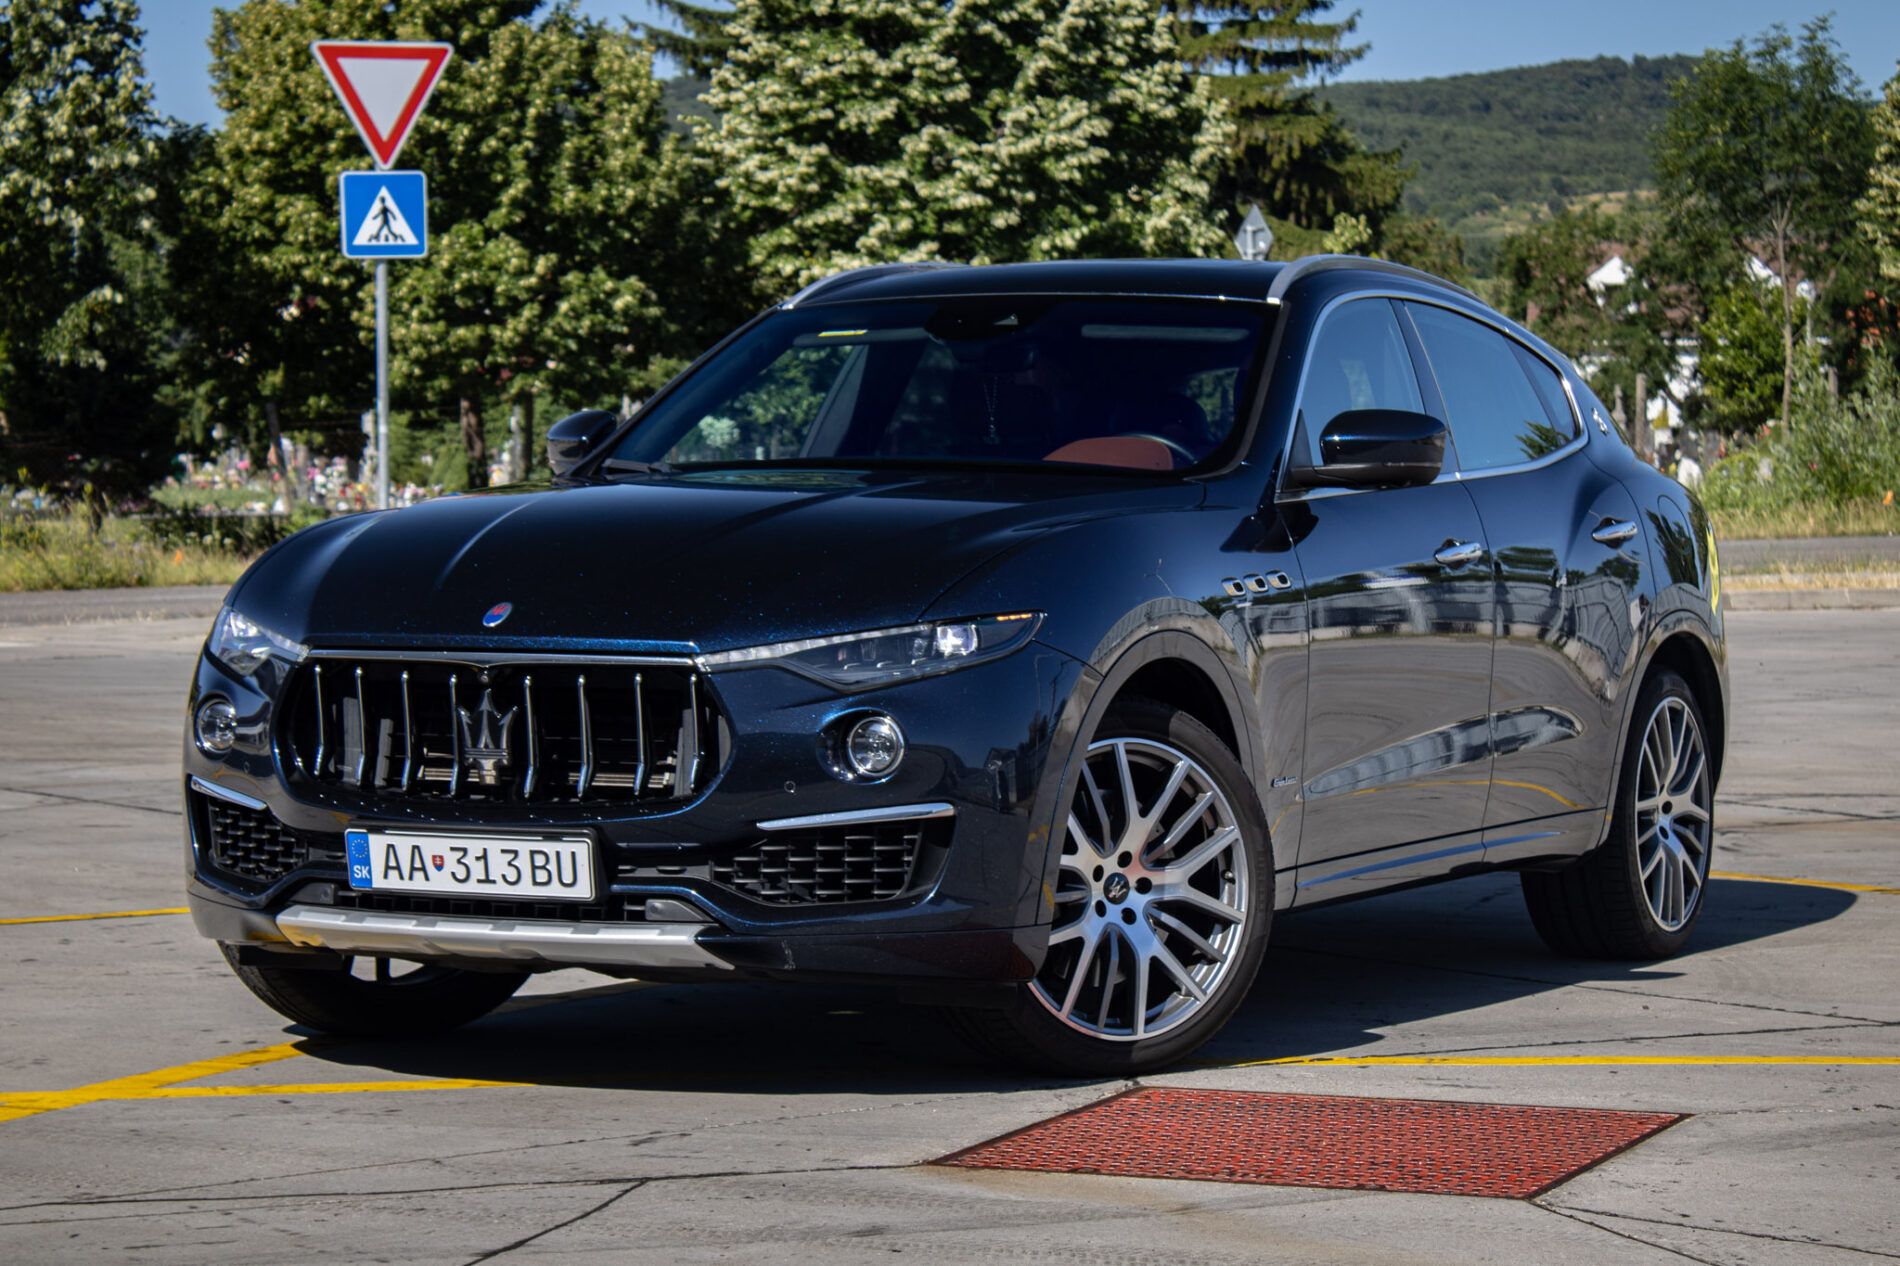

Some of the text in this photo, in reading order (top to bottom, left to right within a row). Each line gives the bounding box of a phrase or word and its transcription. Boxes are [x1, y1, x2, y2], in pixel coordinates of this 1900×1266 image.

[353, 865, 371, 879] SK
[383, 843, 578, 888] AA 313BU
